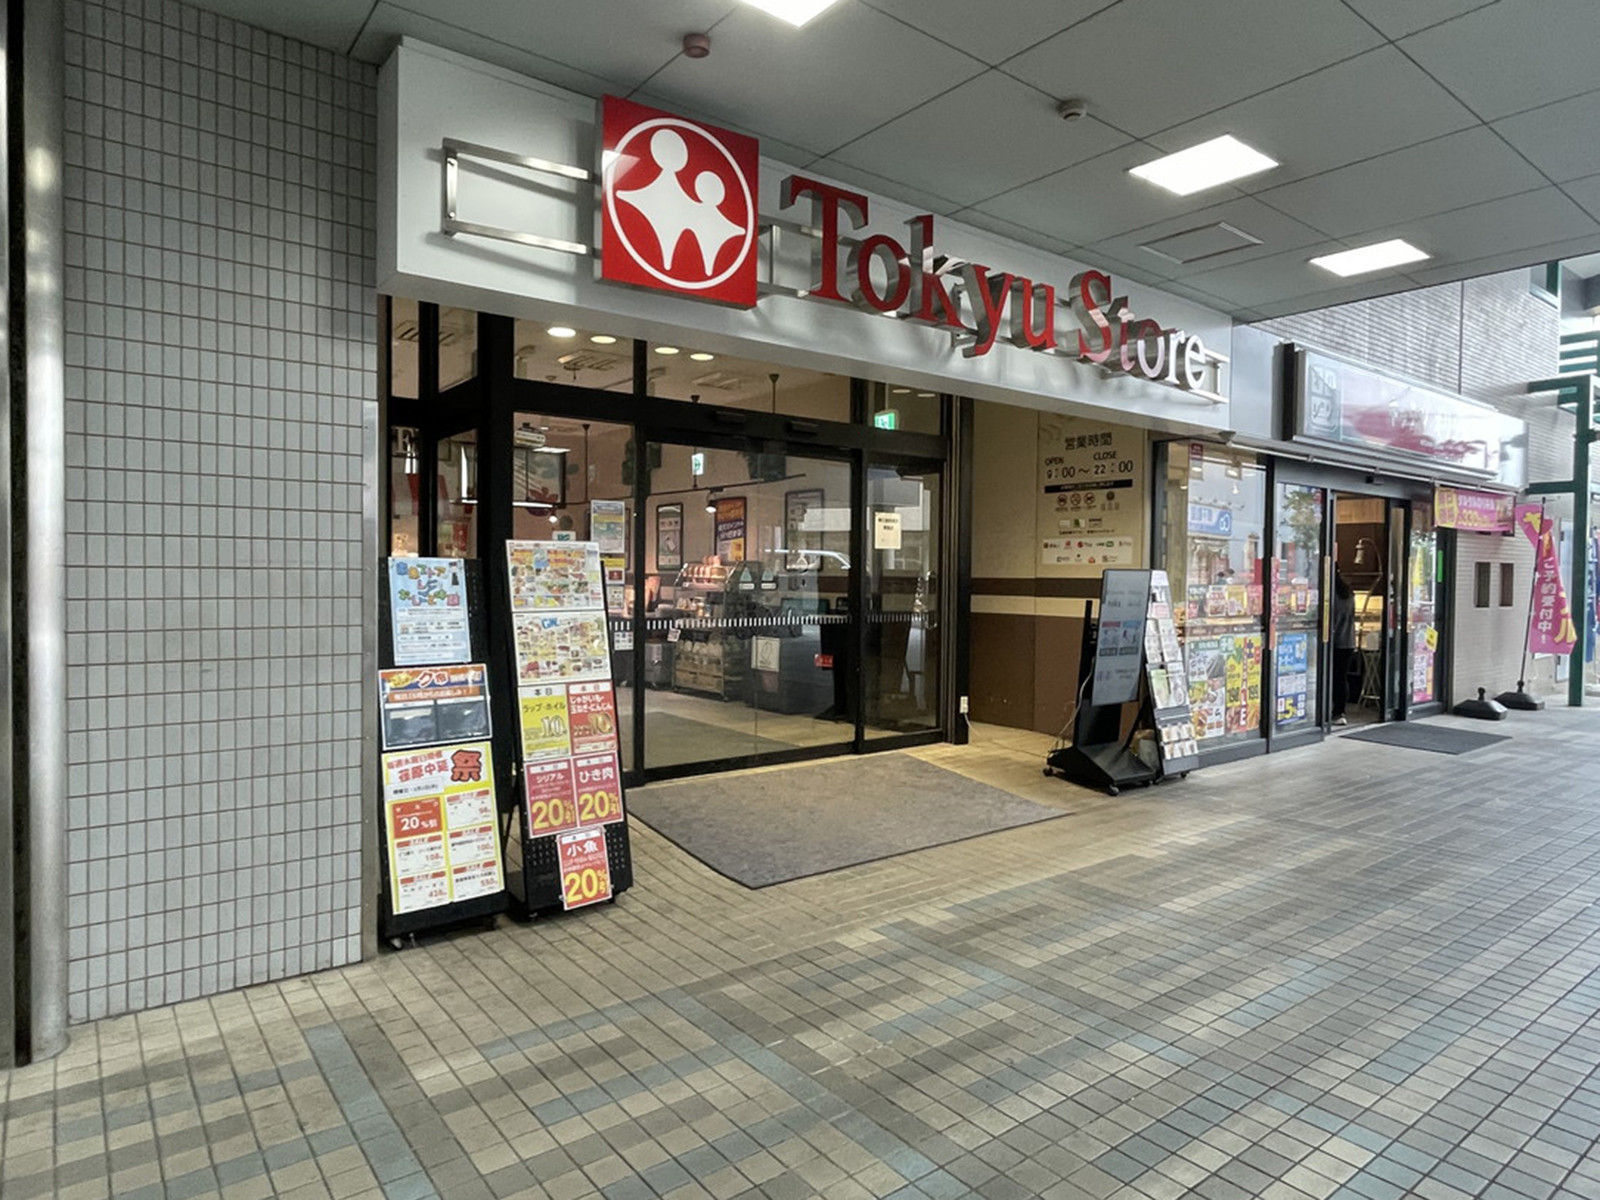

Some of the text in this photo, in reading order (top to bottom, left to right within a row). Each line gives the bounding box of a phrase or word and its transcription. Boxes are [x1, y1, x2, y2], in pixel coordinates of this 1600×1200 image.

[781, 174, 1207, 390] Tokyu Store
[1065, 432, 1113, 450] 営業時間
[1044, 451, 1117, 466] OPEN CLOSE
[451, 749, 482, 782] 祭
[536, 773, 564, 783] シリアル
[579, 767, 613, 783] ひき肉
[566, 840, 599, 857] 小魚
